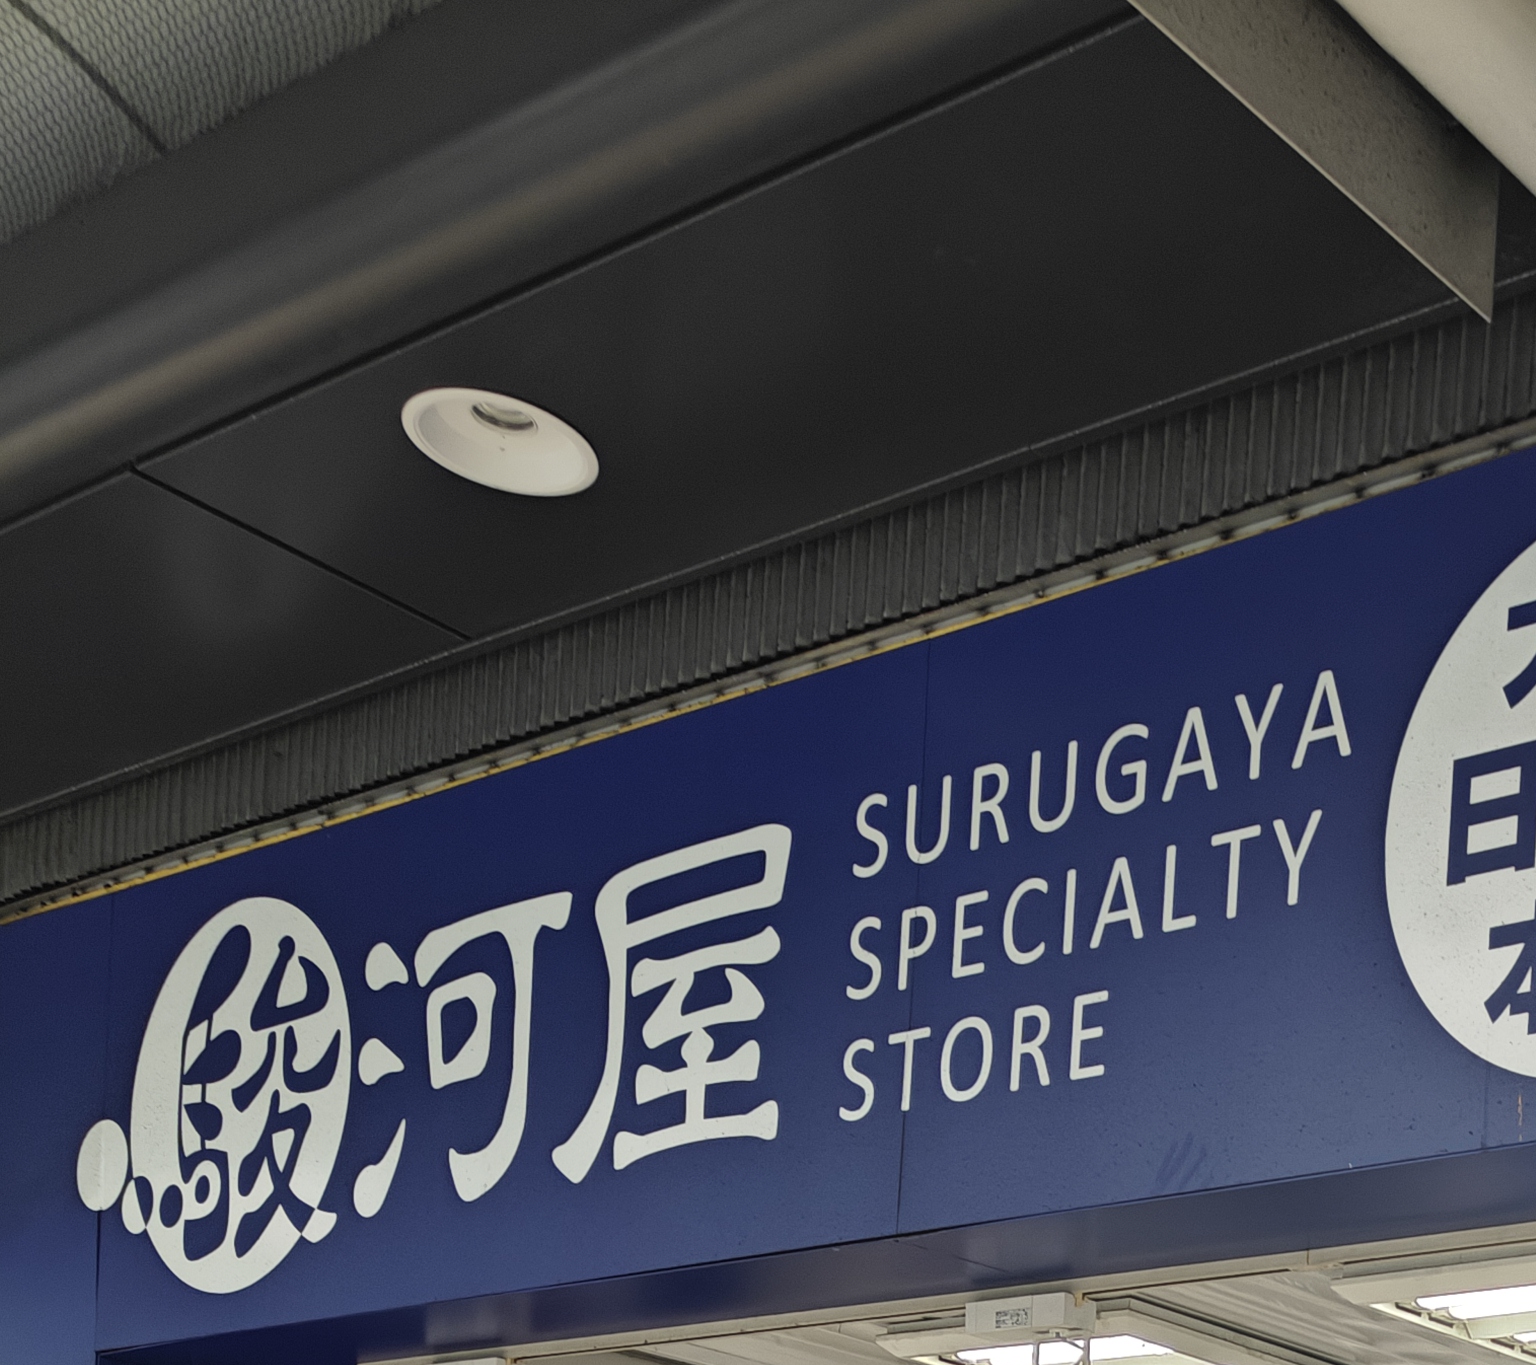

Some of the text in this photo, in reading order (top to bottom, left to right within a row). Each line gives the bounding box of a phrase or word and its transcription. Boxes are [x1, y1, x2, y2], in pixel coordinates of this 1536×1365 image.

[852, 669, 1352, 879] SURUGAYA
[846, 809, 1323, 1000] SPECIALTY
[76, 822, 793, 1295] 駿河屋
[837, 990, 1109, 1122] STORE
